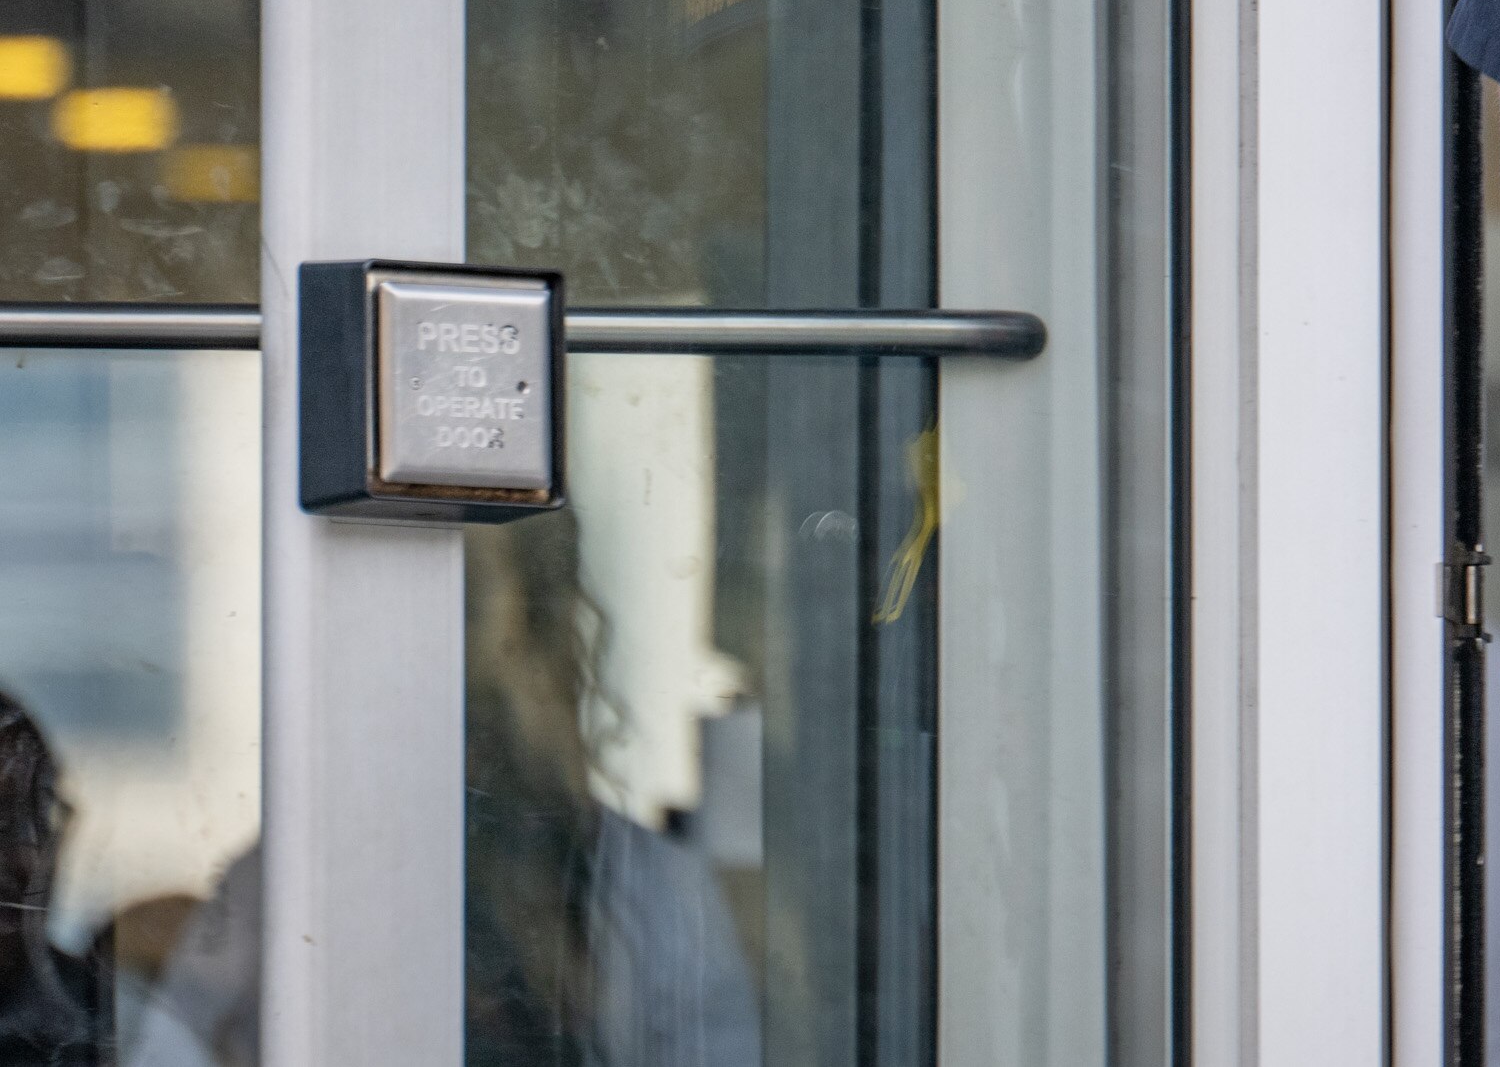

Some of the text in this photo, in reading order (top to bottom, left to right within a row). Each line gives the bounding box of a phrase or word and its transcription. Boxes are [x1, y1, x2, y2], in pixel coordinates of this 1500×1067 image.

[417, 322, 520, 354] PRESS
[453, 365, 487, 388] TO
[416, 395, 525, 420] OPERATE
[437, 426, 505, 449] DOOR
